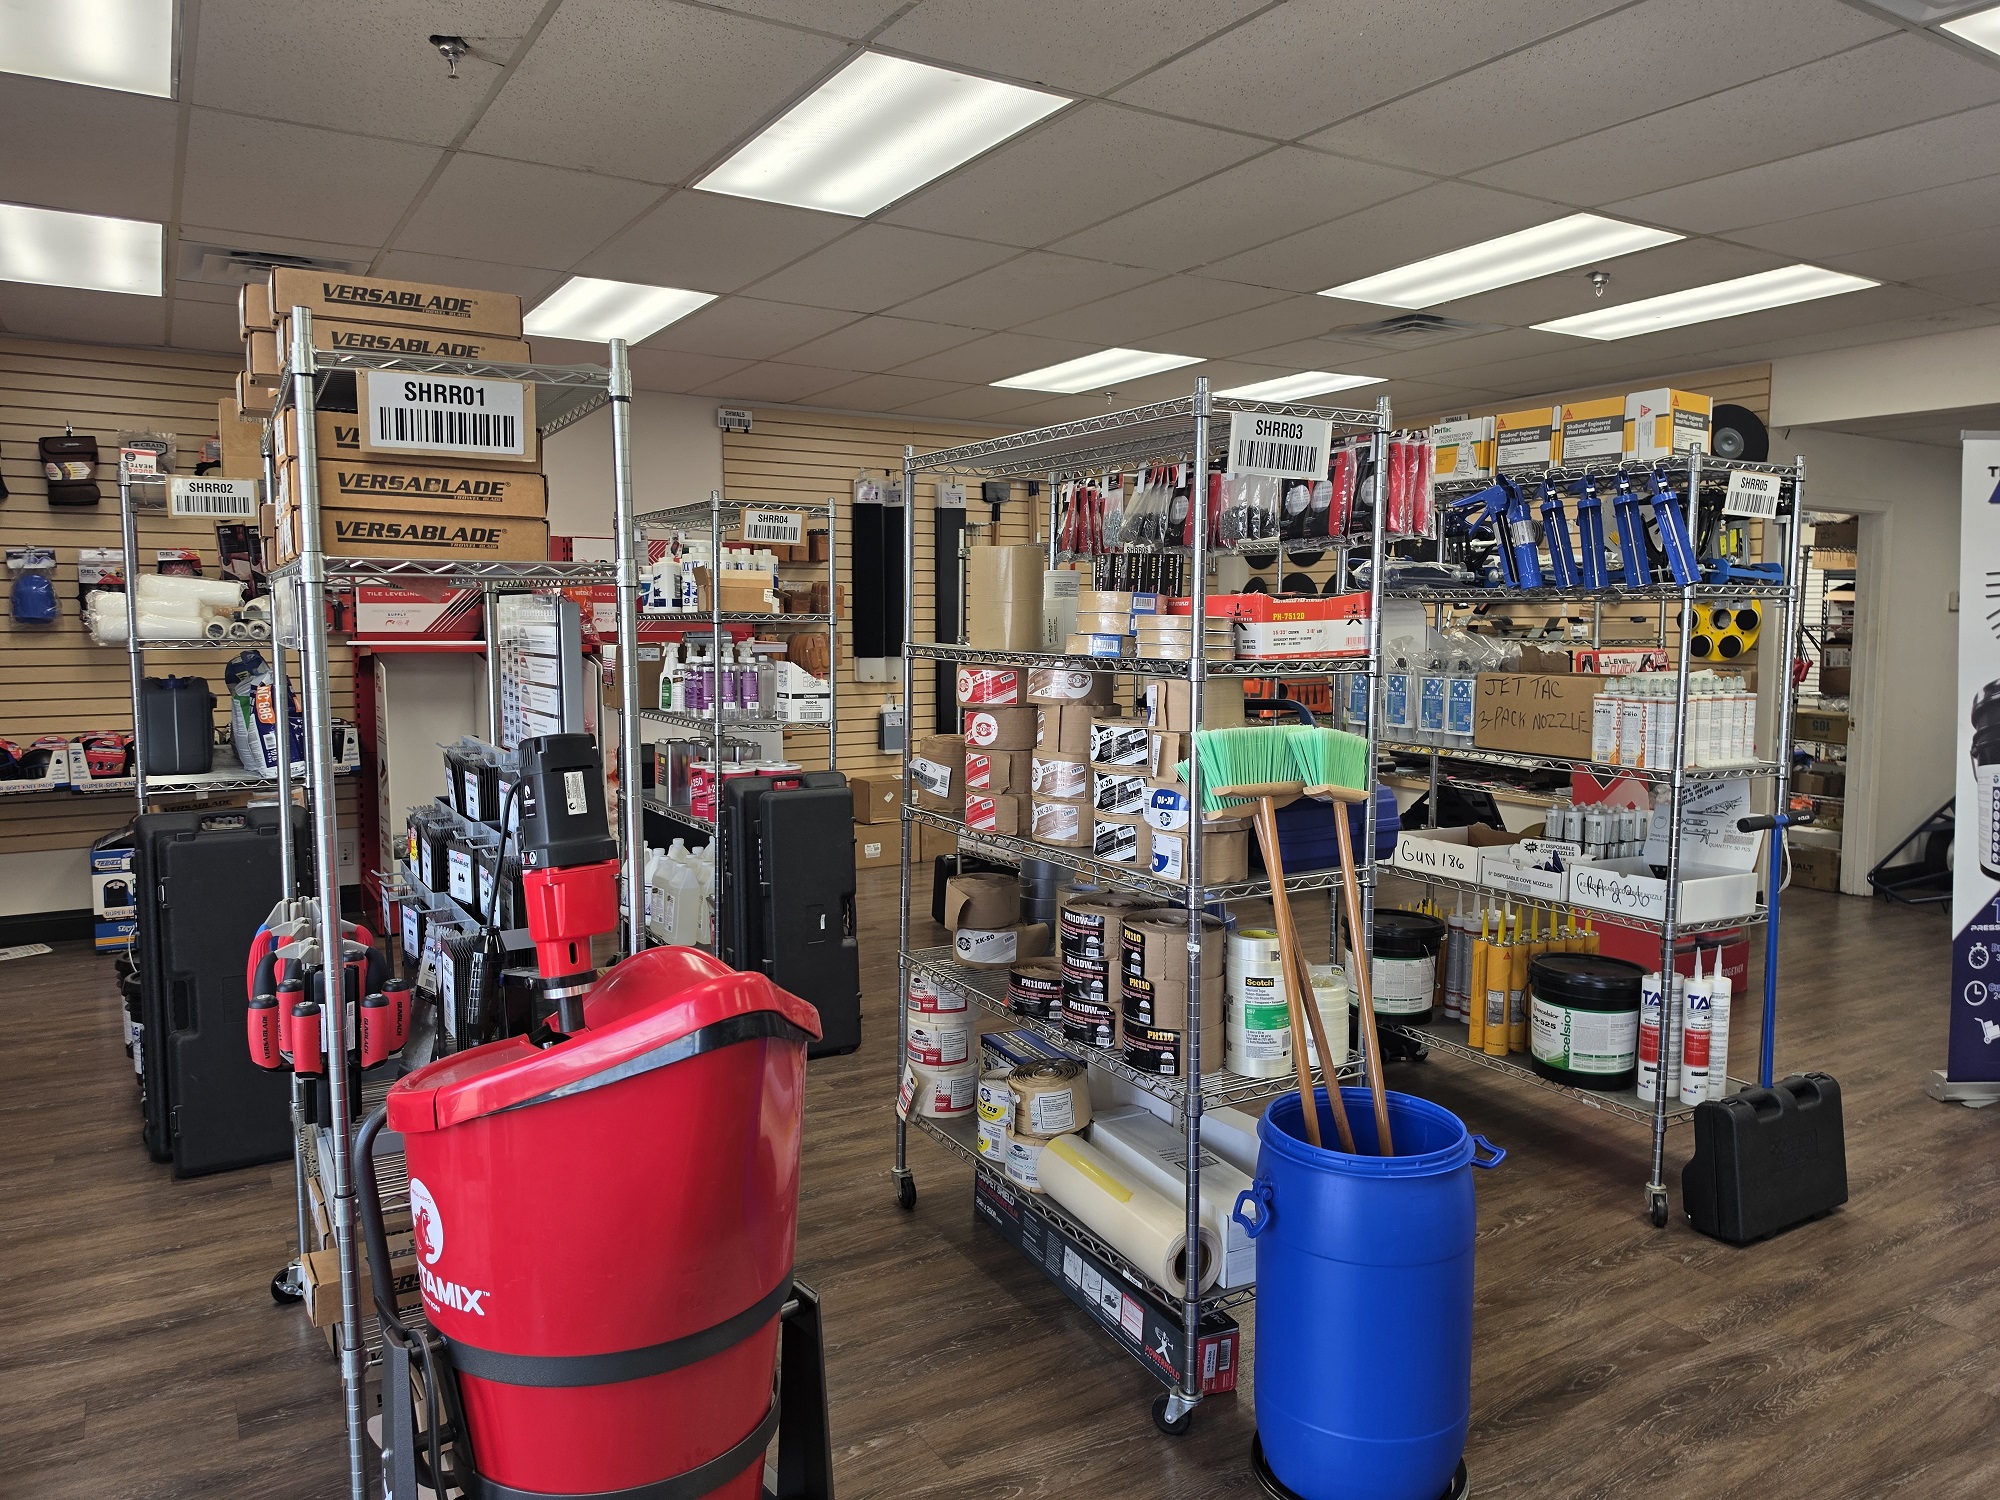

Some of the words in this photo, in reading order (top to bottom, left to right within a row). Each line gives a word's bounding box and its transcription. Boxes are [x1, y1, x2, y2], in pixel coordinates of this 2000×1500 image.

[323, 283, 473, 313] VERSABLADE
[331, 331, 481, 359] VERSABLADE
[404, 381, 485, 406] SHRR01
[1255, 419, 1304, 440] SHRR03
[1434, 426, 1452, 435] DriTac
[1588, 419, 1611, 428] Engineered
[189, 483, 234, 495] SHRR02
[338, 472, 505, 496] VERSABLADE
[1741, 477, 1768, 492] SHRR05
[757, 513, 788, 525] SHRR04
[335, 520, 502, 544] VERSABLADE
[1610, 664, 1637, 675] QUICK
[257, 686, 270, 700] NC
[1485, 676, 1527, 697] JET
[1530, 676, 1563, 700] TAC
[258, 702, 273, 721] 886
[1478, 706, 1526, 731] 3-PACK
[1532, 711, 1591, 734] NOZZLE
[81, 782, 122, 790] SUPER-SOFT
[163, 799, 233, 813] VERSABLADE
[1402, 840, 1436, 867] GUN
[1442, 853, 1465, 871] 186
[1545, 844, 1575, 852] DISPOSABLE
[1493, 872, 1520, 882] DISPOSABLE
[1519, 877, 1532, 885] COVE
[1532, 880, 1554, 889] NOZZLES
[1124, 928, 1141, 943] PH110
[1970, 924, 2000, 932] PRESS
[975, 934, 995, 945] XK-50
[1021, 978, 1051, 990] PH110W
[1129, 977, 1150, 991] PH110
[1246, 978, 1273, 987] Scotch
[1643, 989, 1661, 1007] TA
[1069, 1000, 1098, 1015] PH110W
[262, 1015, 271, 1060] VERSABLADE
[1147, 1030, 1174, 1042] PH110
[987, 1104, 998, 1114] DS
[996, 1185, 1016, 1207] SHIELD
[418, 1262, 485, 1317] TAMIX
[1144, 1344, 1181, 1380] POWERHOLD
